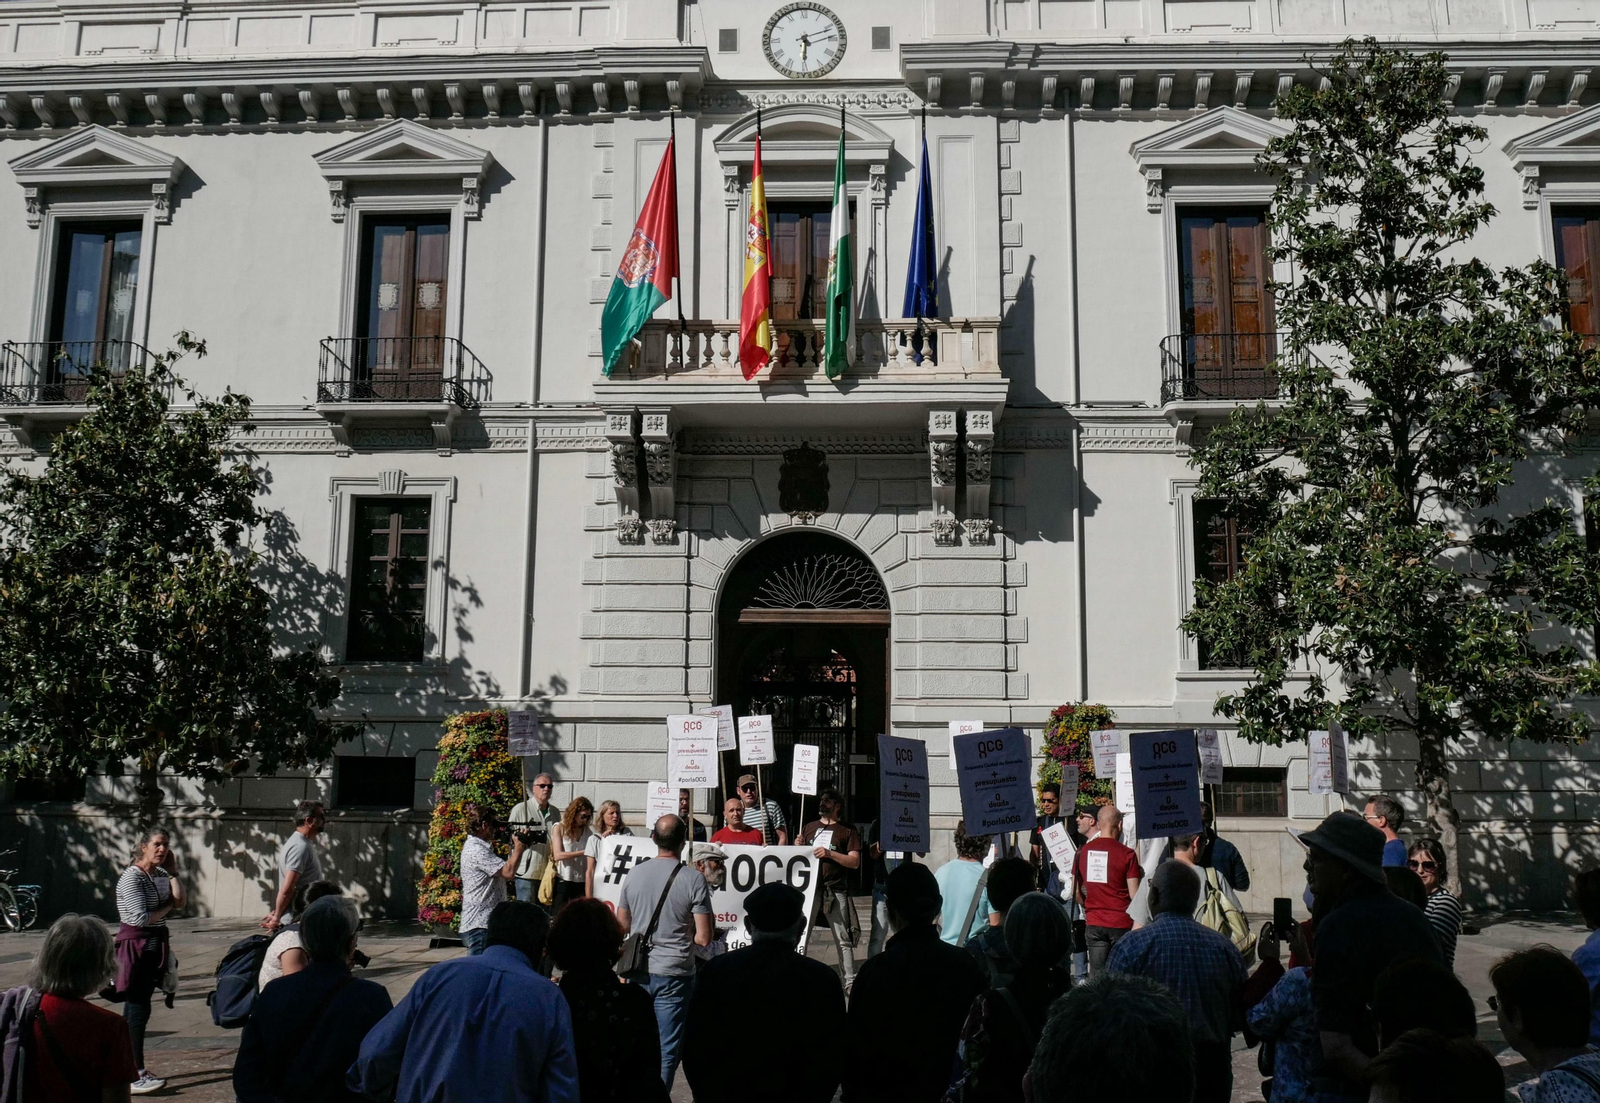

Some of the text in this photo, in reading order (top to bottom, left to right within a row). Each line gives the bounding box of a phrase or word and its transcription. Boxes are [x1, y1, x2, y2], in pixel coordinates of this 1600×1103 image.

[684, 721, 702, 734] OCG
[749, 720, 761, 728] OCG
[978, 739, 1004, 758] OCG
[1153, 741, 1176, 759] OCG
[895, 748, 913, 766] OCG
[975, 776, 1016, 787] presupuesto
[1148, 780, 1187, 789] presupuesto
[891, 790, 920, 798] presupuesto
[989, 800, 1009, 808] deuda
[982, 815, 1021, 827] #porlaOCG
[1152, 820, 1188, 830] #porlaOCG
[892, 834, 920, 843] #porlaOCG
